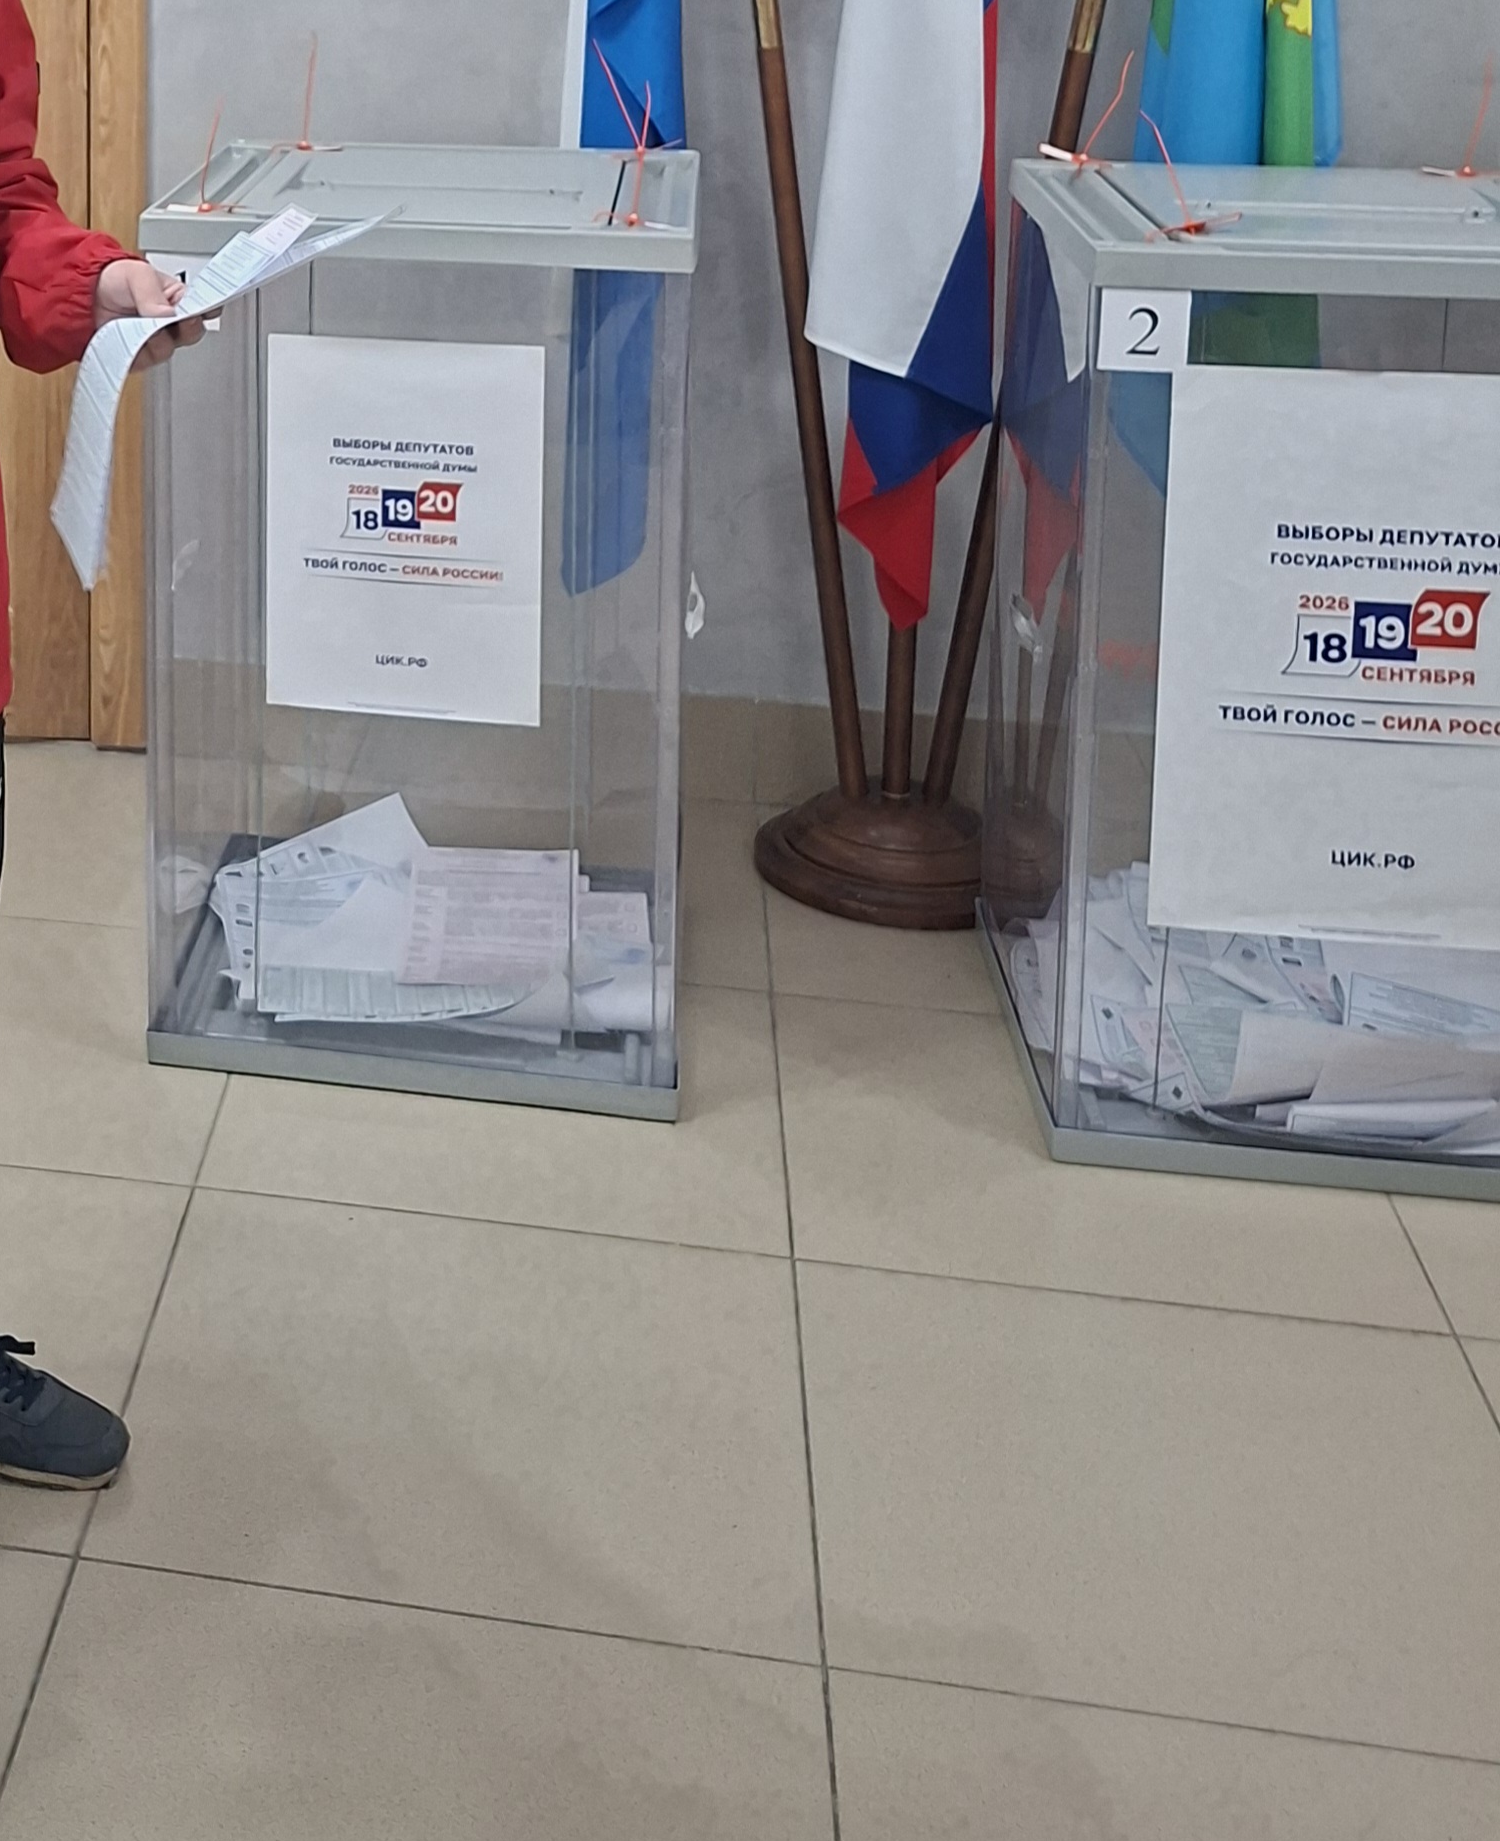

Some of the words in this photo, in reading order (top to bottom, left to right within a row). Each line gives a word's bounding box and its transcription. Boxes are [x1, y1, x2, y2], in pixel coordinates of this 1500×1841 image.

[1126, 306, 1161, 357] 2
[332, 437, 392, 452] ВЫБОРЫ
[394, 441, 474, 456] ДЕПУТАТОВ
[329, 456, 440, 471] ГОСУДАРСТВЕННОЙ
[441, 460, 478, 473] ДУМЫ
[348, 484, 380, 496] 2026
[351, 509, 379, 531] 18
[384, 498, 414, 522] 19
[418, 489, 455, 514] 20
[387, 531, 458, 546] СЕНТЯБРЯ
[1276, 523, 1374, 543] ВЫБОРЫ
[1379, 528, 1500, 549] ДЕПУТАТО
[304, 556, 339, 570] ТВОЙ
[342, 559, 388, 573] ГОЛОС
[402, 564, 439, 576] СИЛА
[1270, 551, 1452, 573] ГОСУДАРСТВЕННОЙ
[1457, 560, 1500, 576] ДУМ
[1298, 594, 1350, 610] 2026
[1303, 631, 1348, 664] 18
[1358, 615, 1406, 650] 19
[1415, 601, 1474, 638] 20
[375, 654, 428, 668] ЦИК.РФ
[1361, 665, 1476, 686] СЕНТЯБРЯ
[1218, 703, 1277, 724] ТВОЙ
[1283, 708, 1356, 728] ГОЛОС
[1382, 714, 1442, 733] СИЛА
[1331, 849, 1416, 870] ЦИК.РФ
